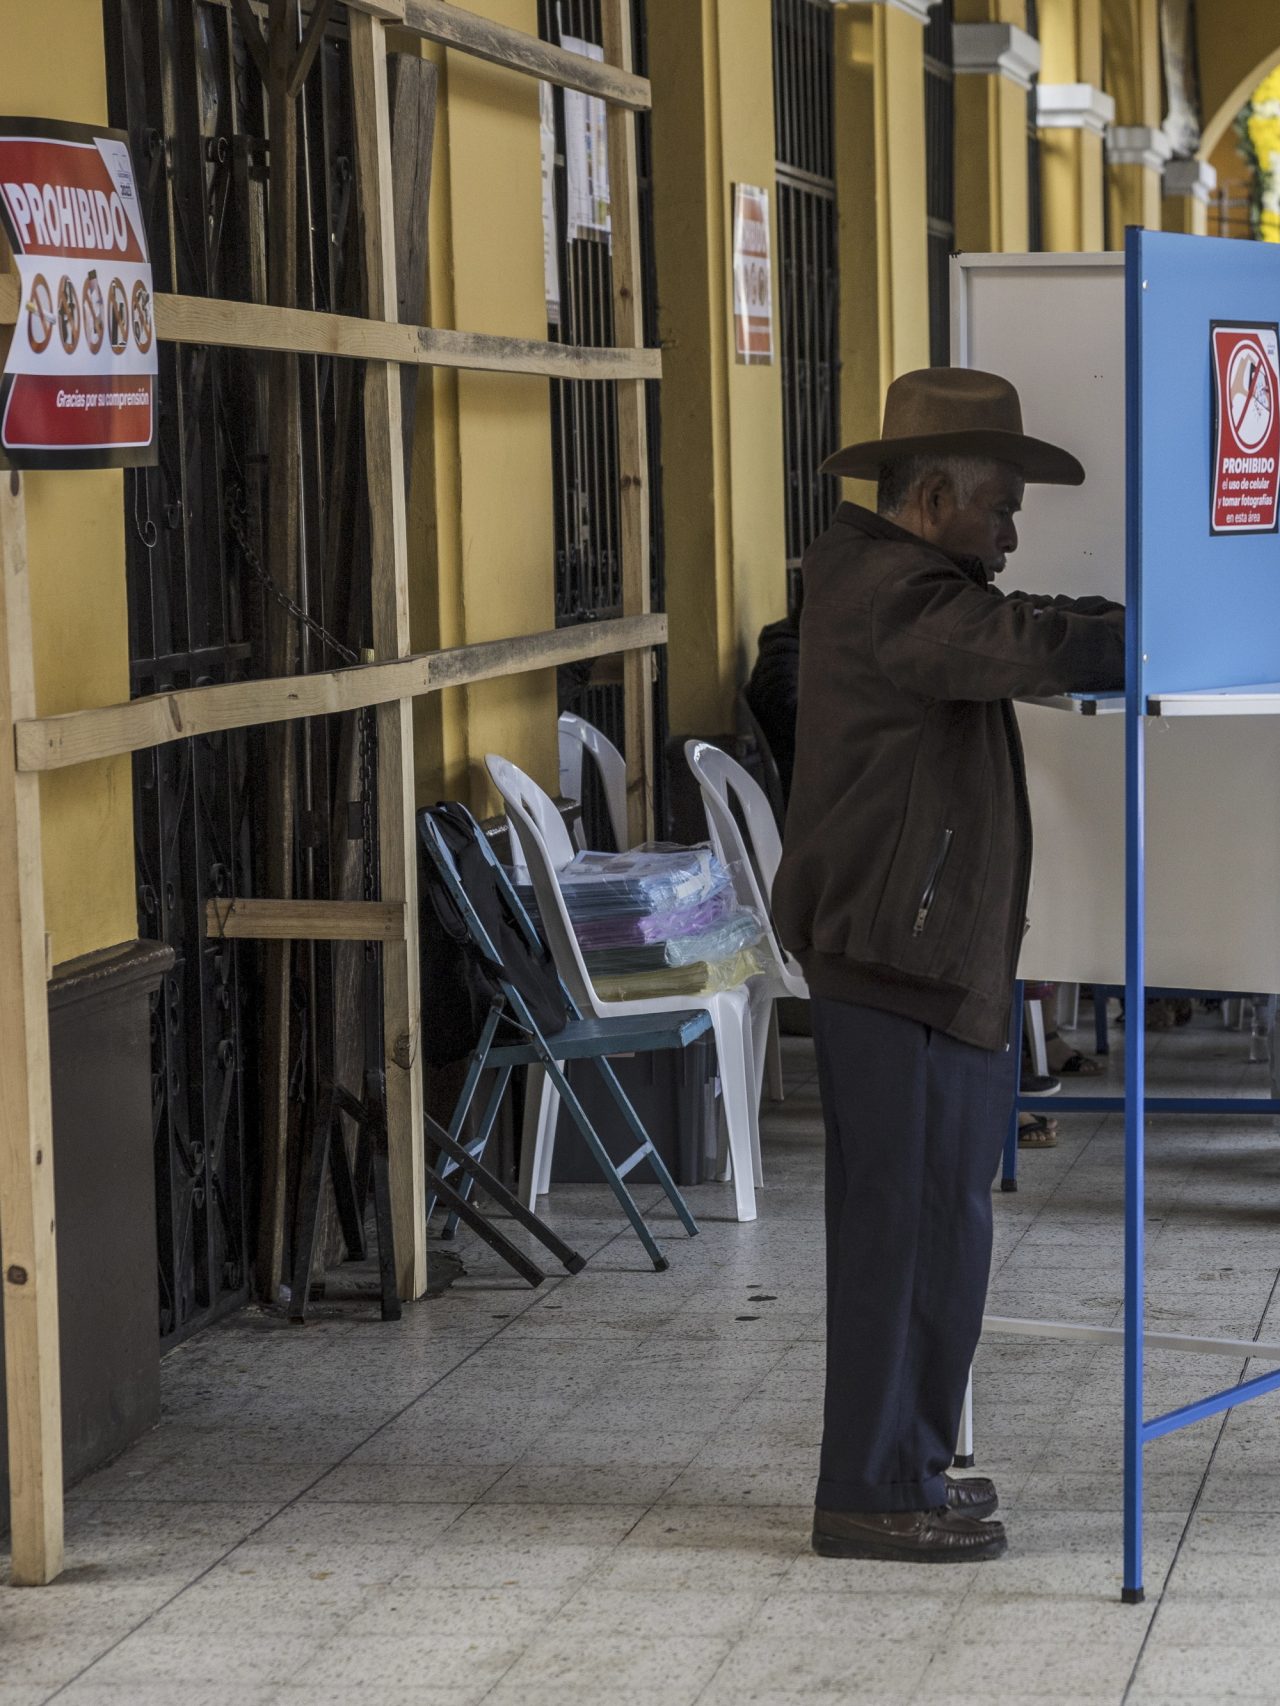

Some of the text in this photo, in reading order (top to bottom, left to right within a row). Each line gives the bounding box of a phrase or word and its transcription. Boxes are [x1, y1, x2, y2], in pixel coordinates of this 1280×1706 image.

[3, 183, 128, 252] PROHIBIDO
[56, 387, 150, 411] Gracias por su comprensión
[1222, 457, 1275, 474] PROHIBIDO
[1222, 477, 1270, 490] el uso de celular
[1217, 498, 1222, 509] y
[1222, 496, 1240, 507] tomar
[1226, 510, 1261, 524] en esta área
